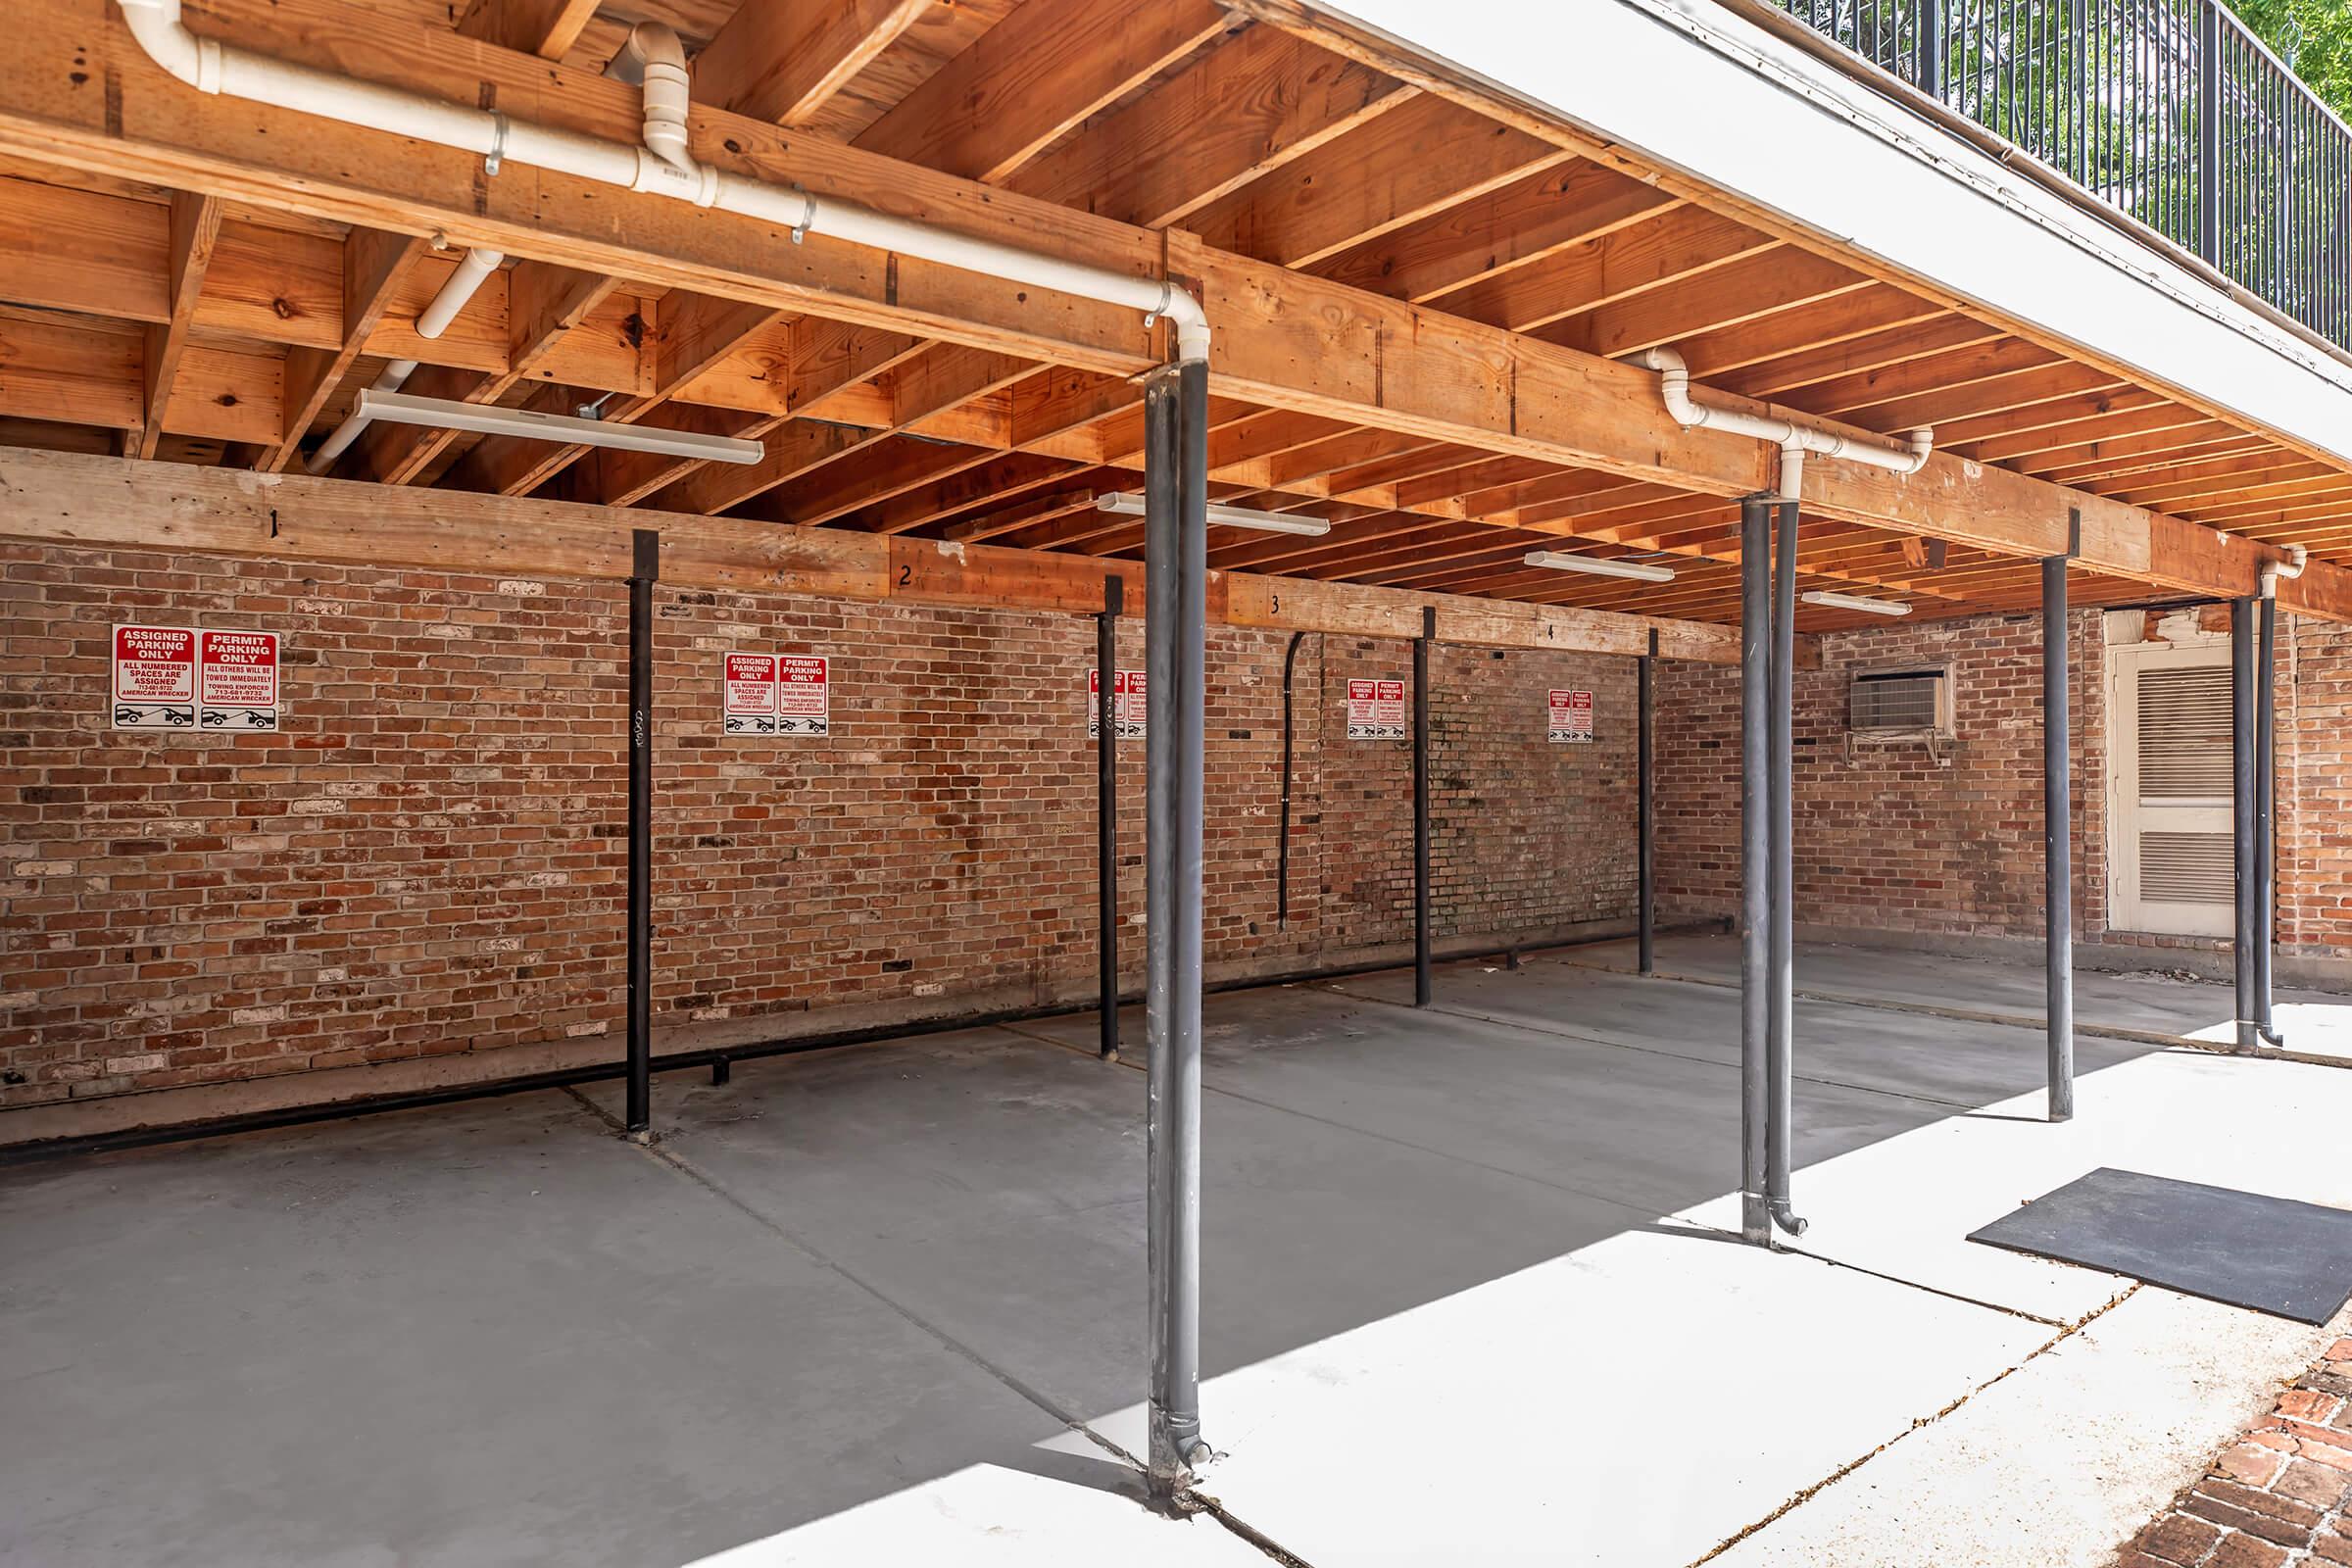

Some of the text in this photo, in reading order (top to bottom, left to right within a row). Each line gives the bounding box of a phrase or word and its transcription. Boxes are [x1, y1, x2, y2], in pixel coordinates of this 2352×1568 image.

[270, 509, 278, 538] 1
[900, 564, 911, 586] 2
[1271, 595, 1279, 614] 3
[123, 630, 188, 641] ASSIGNED
[1548, 624, 1554, 640] 4
[127, 640, 185, 651] PARKING
[213, 635, 266, 645] PERMIT
[138, 650, 173, 659] ONLY
[208, 644, 270, 655] PARKING
[220, 654, 258, 663] ONLY
[731, 657, 771, 665] ASSIGNED
